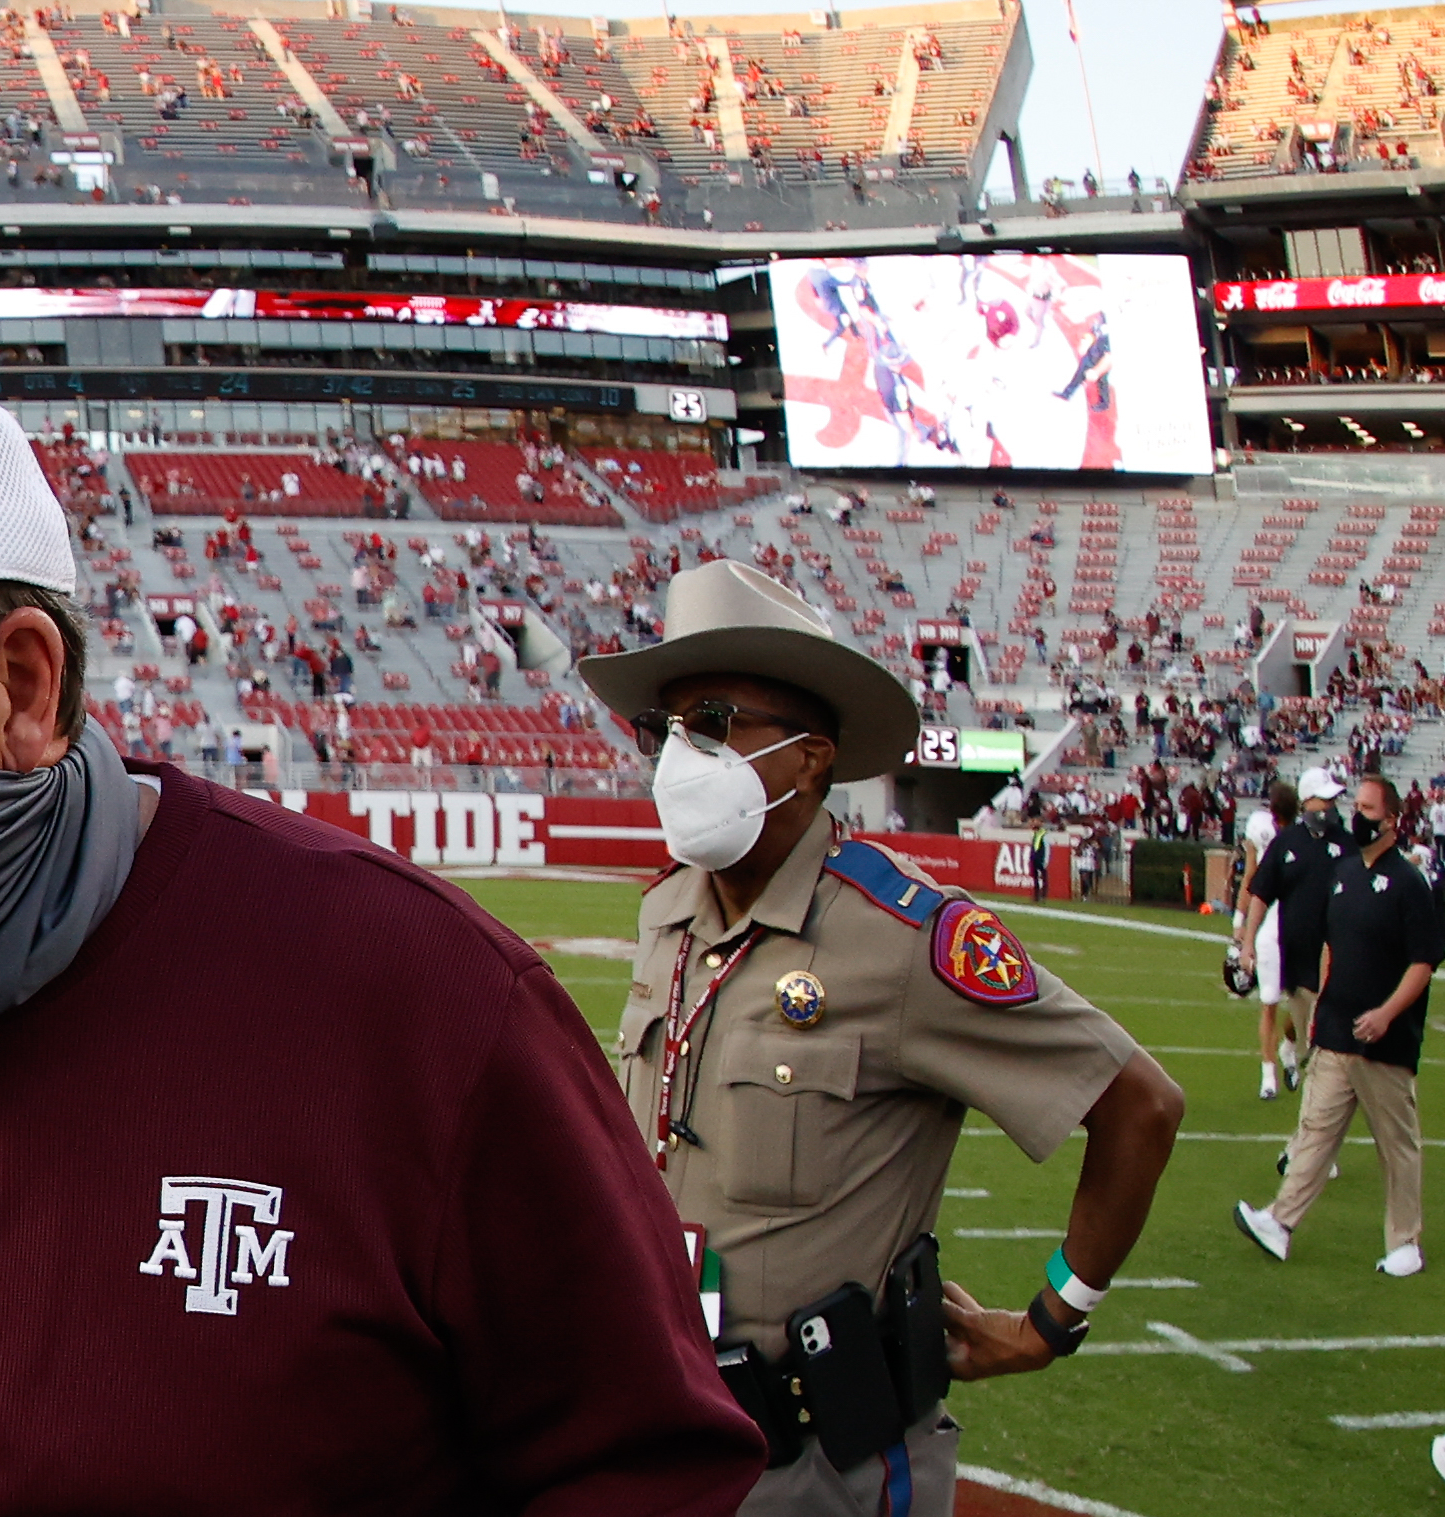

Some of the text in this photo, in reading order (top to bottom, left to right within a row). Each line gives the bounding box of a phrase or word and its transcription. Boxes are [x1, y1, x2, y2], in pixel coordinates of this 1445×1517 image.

[672, 393, 702, 418] 25
[923, 729, 956, 761] 25
[350, 792, 546, 866] TIDE
[994, 842, 1033, 875] Alf
